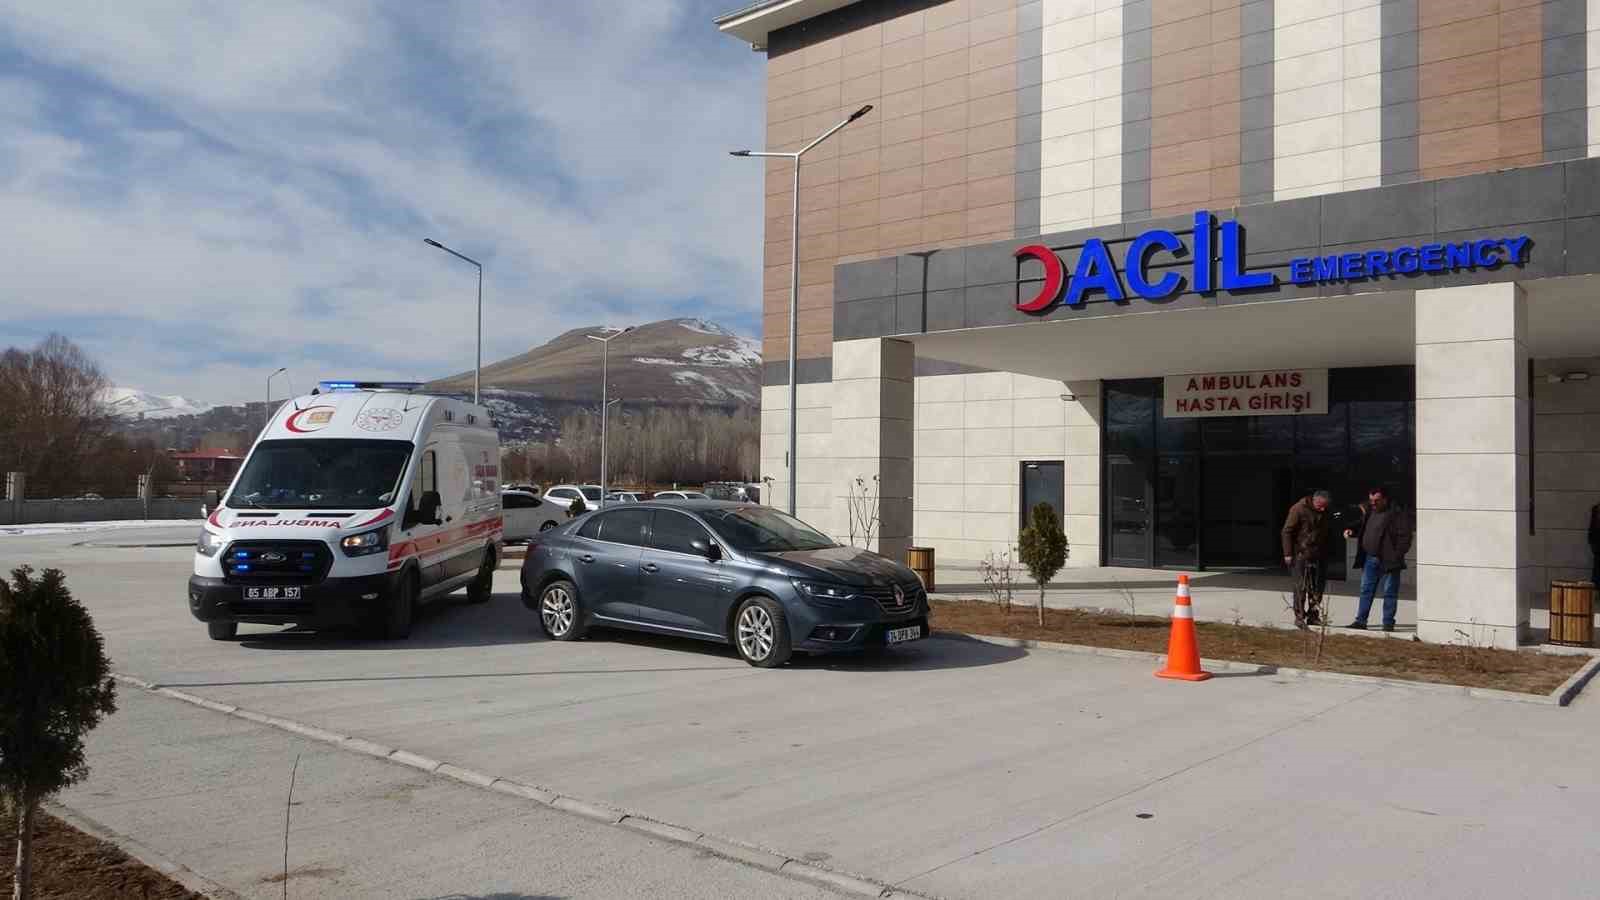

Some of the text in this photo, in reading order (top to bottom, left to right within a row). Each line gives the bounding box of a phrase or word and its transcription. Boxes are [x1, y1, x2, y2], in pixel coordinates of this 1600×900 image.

[1064, 210, 1531, 305] ACİL EMERGENCY
[1186, 372, 1303, 392] AMBULANS
[1176, 391, 1311, 412] HASTA GİRİŞİ
